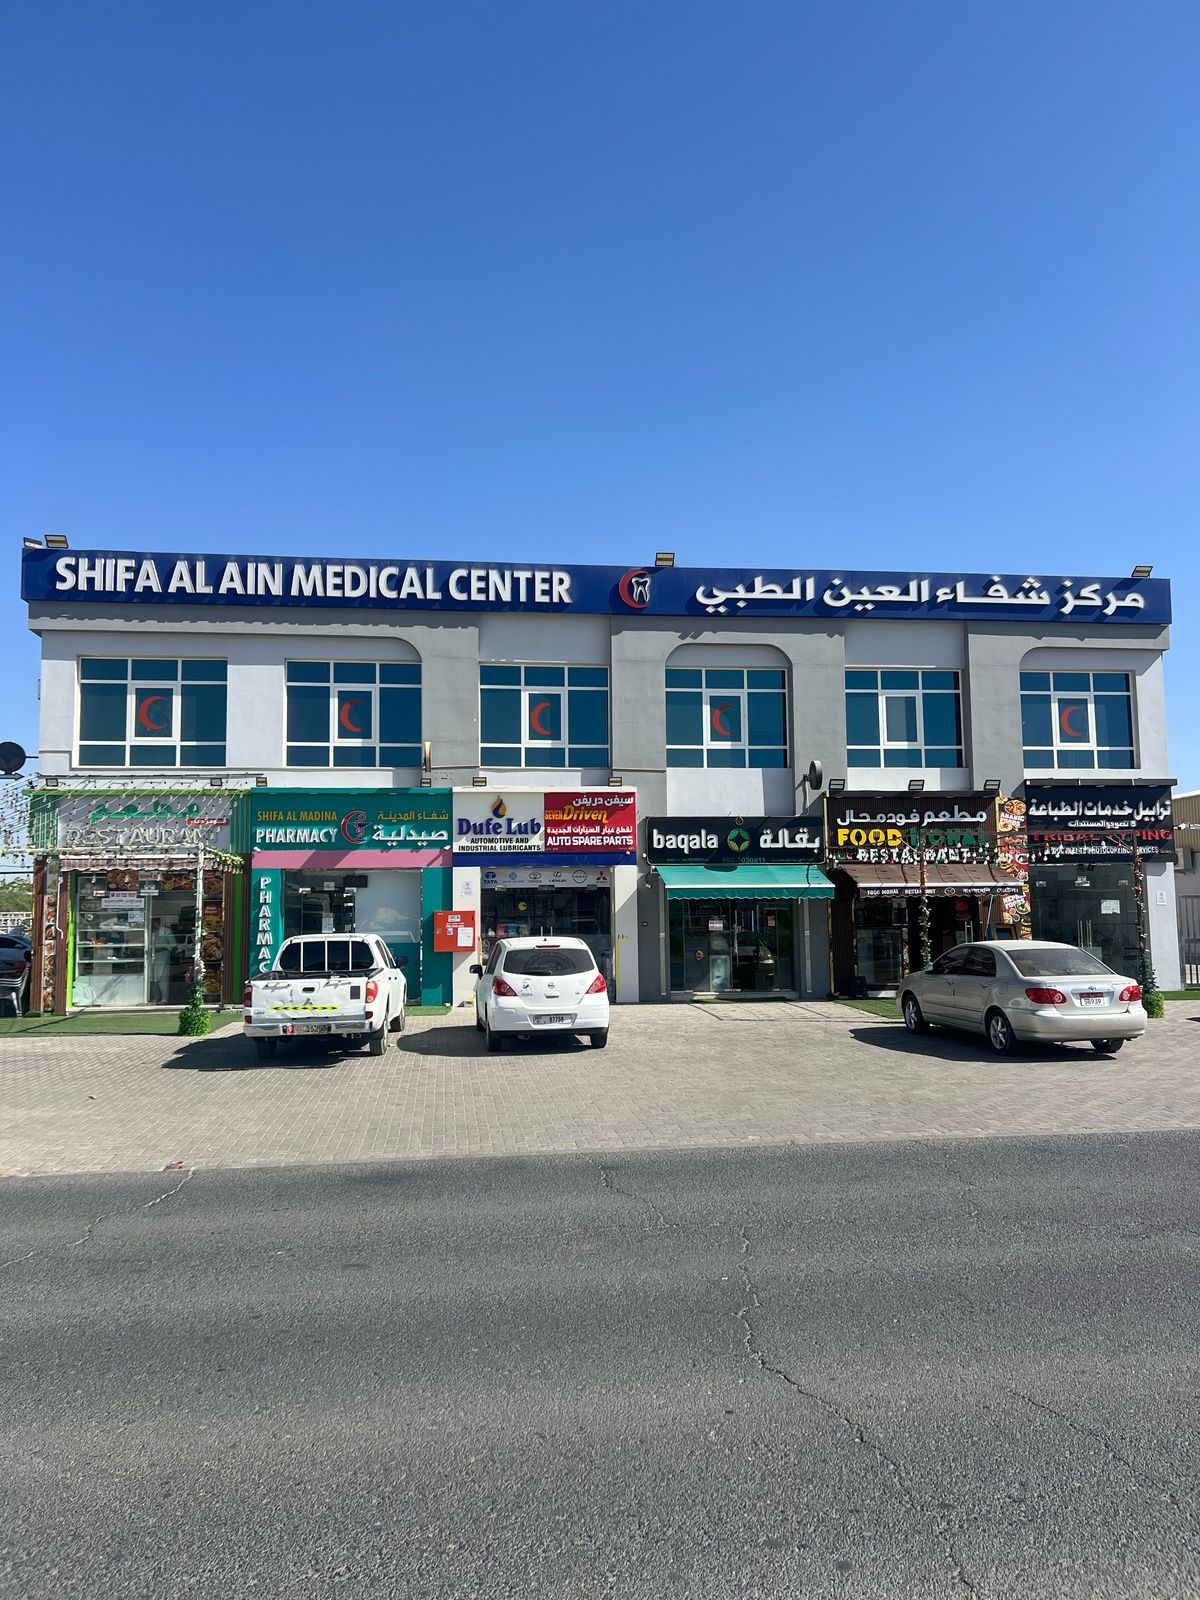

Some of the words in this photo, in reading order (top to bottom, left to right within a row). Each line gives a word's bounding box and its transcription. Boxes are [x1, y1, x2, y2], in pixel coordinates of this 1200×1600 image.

[55, 555, 162, 594] SHIFA
[168, 560, 213, 594] AL
[219, 561, 283, 597] AIN
[291, 564, 442, 600] MEDICAL
[448, 568, 573, 603] CENTER
[696, 575, 814, 613] الطبي
[823, 577, 929, 611] العين
[937, 575, 1051, 606] شفاء
[1059, 578, 1146, 615] مركز
[604, 795, 634, 806] سيفن
[1028, 798, 1083, 822] الطباعة
[1084, 799, 1134, 816] خدمات
[257, 811, 284, 821] SHIFA
[286, 811, 298, 821] AL
[300, 811, 338, 821] MADINA
[377, 810, 415, 821] المدينة
[417, 810, 449, 821] شفاء
[544, 809, 563, 820] SEVEN
[563, 805, 608, 823] Driven
[922, 805, 988, 827] مطعم
[256, 827, 338, 843] PHARMACY
[372, 824, 449, 846] صيدلية
[457, 818, 504, 836] Dufe
[506, 818, 541, 836] Lub
[837, 828, 902, 846] FOOD
[547, 836, 571, 846] AUTO
[572, 836, 603, 846] SPARE
[603, 836, 634, 846] PARTS
[652, 828, 719, 855] baqala
[759, 827, 820, 853] بقالة
[256, 876, 273, 973] PHARMAC
